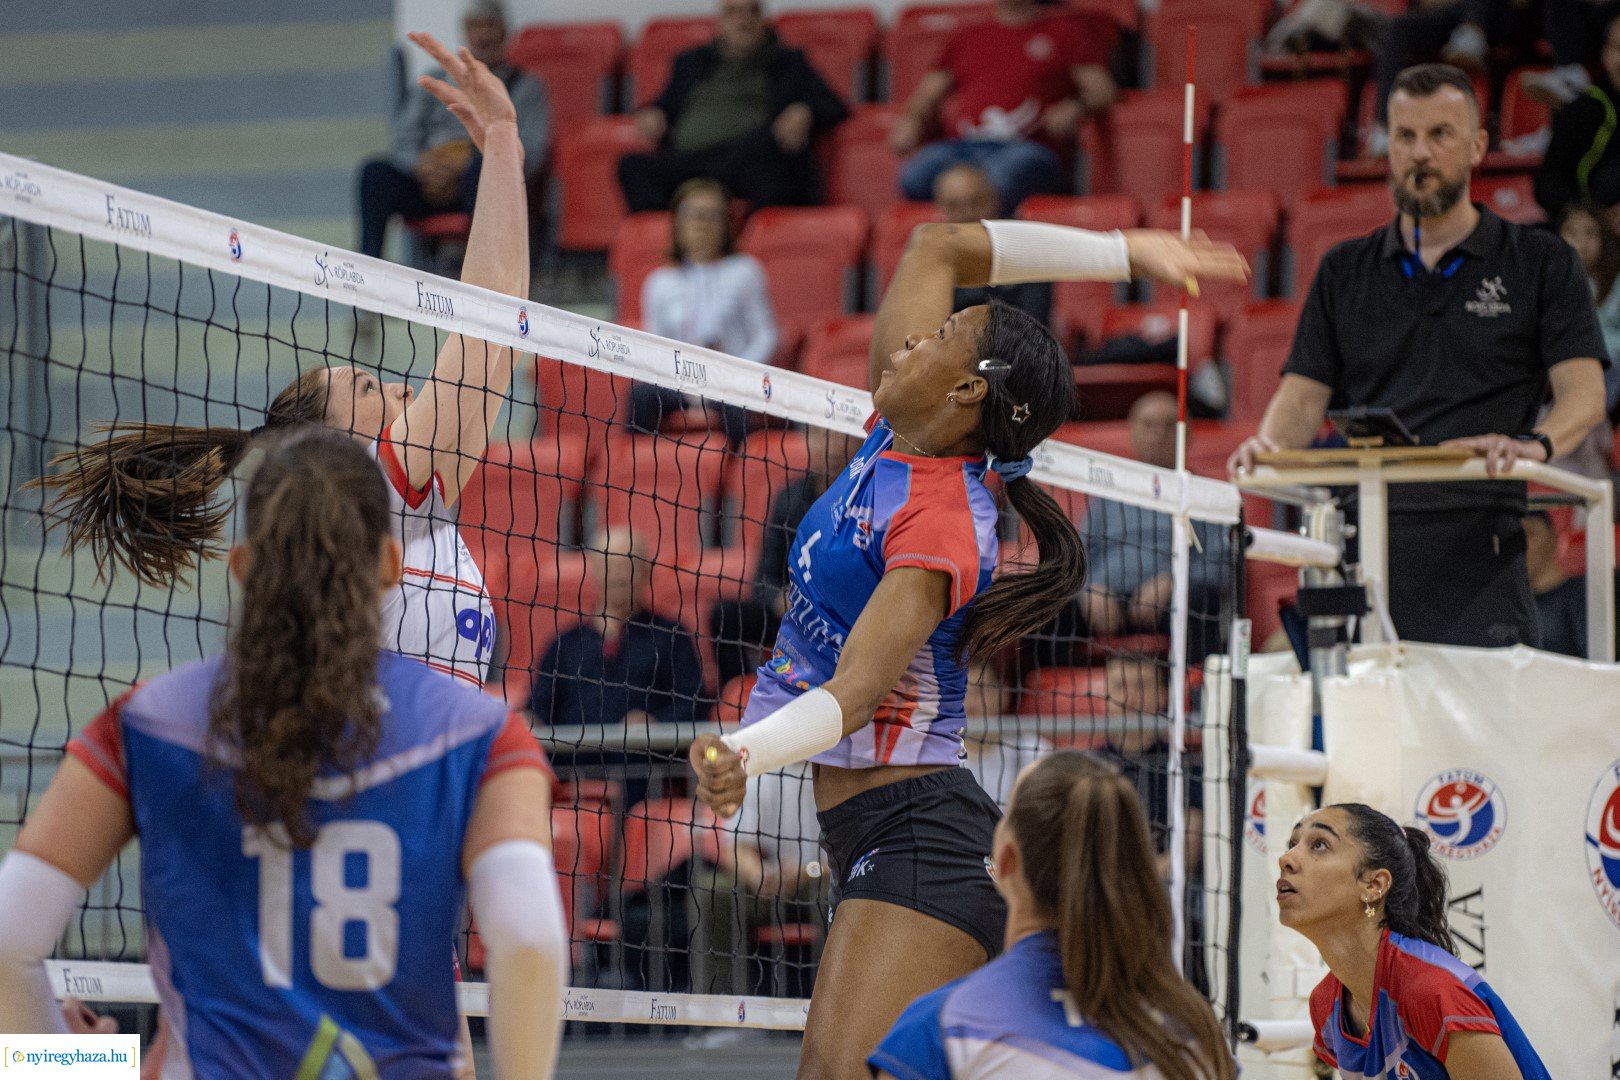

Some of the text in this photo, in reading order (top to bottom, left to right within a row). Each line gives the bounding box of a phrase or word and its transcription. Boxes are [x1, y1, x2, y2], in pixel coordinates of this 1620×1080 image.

[105, 194, 152, 236] FATUM
[416, 280, 454, 316] FATUM
[674, 350, 707, 382] FATUM
[241, 819, 403, 992] 18
[62, 967, 104, 995] FATUM
[650, 998, 677, 1020] FATUM
